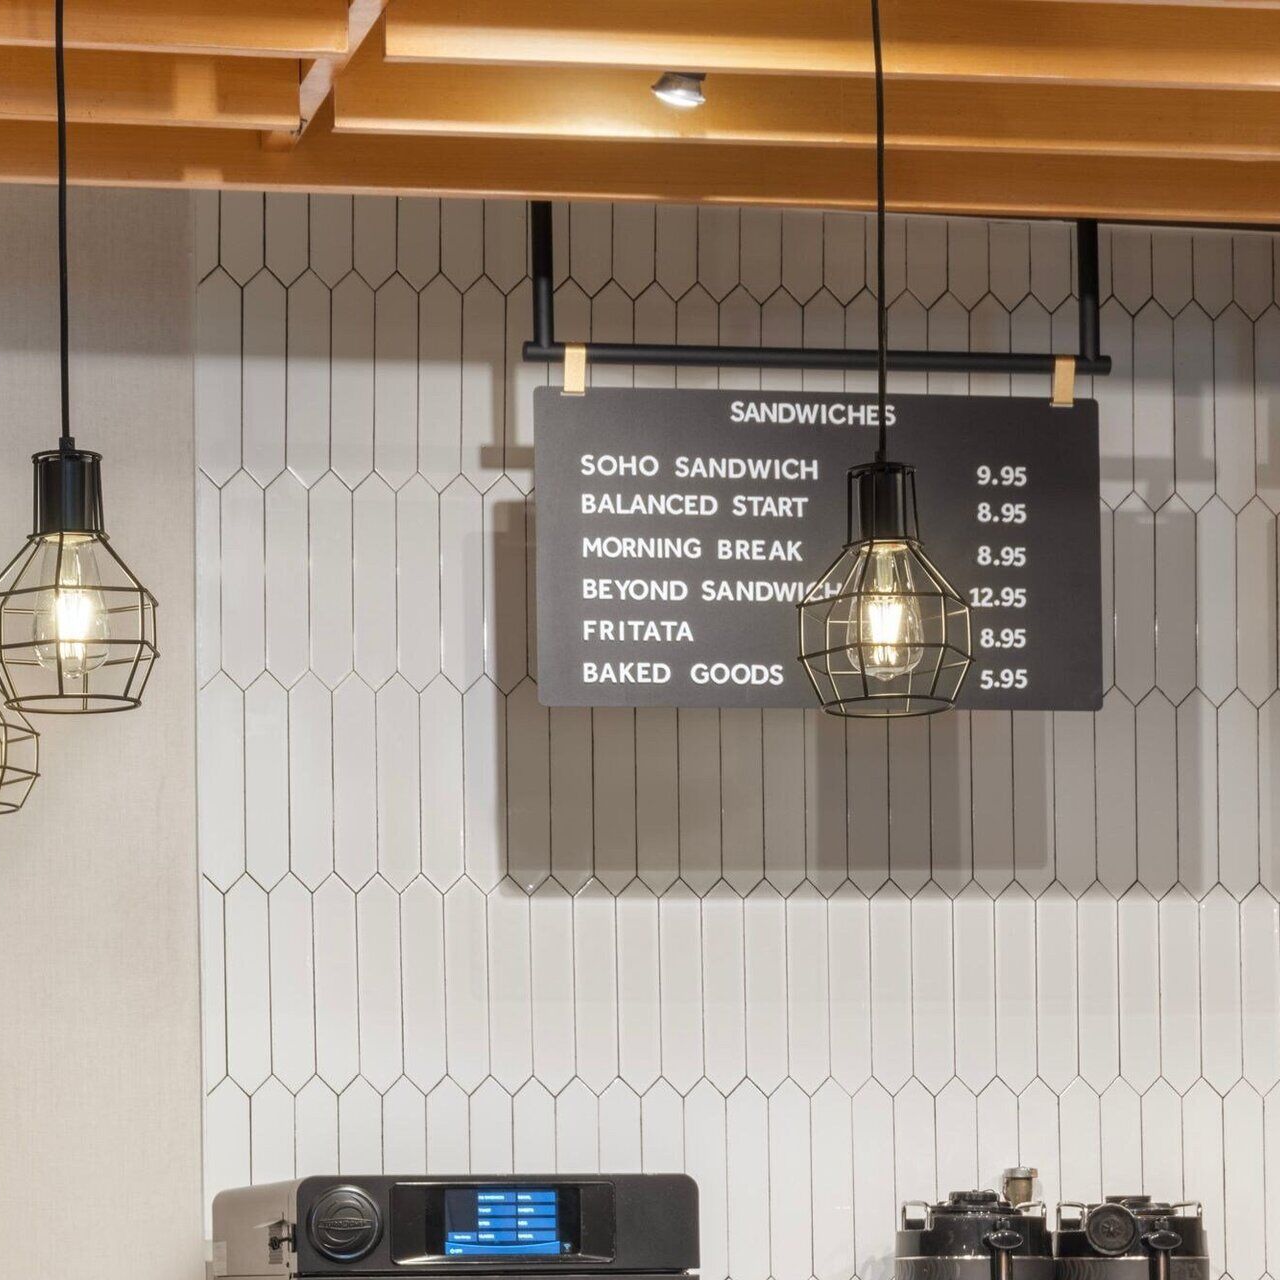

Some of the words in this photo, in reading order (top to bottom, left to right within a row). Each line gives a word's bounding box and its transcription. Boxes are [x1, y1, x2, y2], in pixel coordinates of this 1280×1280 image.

[730, 401, 896, 426] SANDWICHES
[580, 454, 659, 477] SOHO
[675, 456, 819, 480] SANDWICH
[976, 465, 1027, 487] 9.95
[581, 493, 718, 516] BALANCED
[732, 495, 809, 518] START
[977, 502, 1027, 524] 8.95
[582, 536, 702, 559] MORNING
[717, 539, 803, 562] BREAK
[976, 545, 1027, 567] 8.95
[582, 578, 688, 601] BEYOND
[701, 580, 843, 602] SANDWICH
[969, 587, 1027, 608] 12.95
[583, 620, 695, 642] FRITATA
[980, 628, 1027, 649] 8.95
[582, 662, 671, 685] BAKED
[690, 663, 784, 686] GOODS
[980, 668, 1028, 690] 5.95
